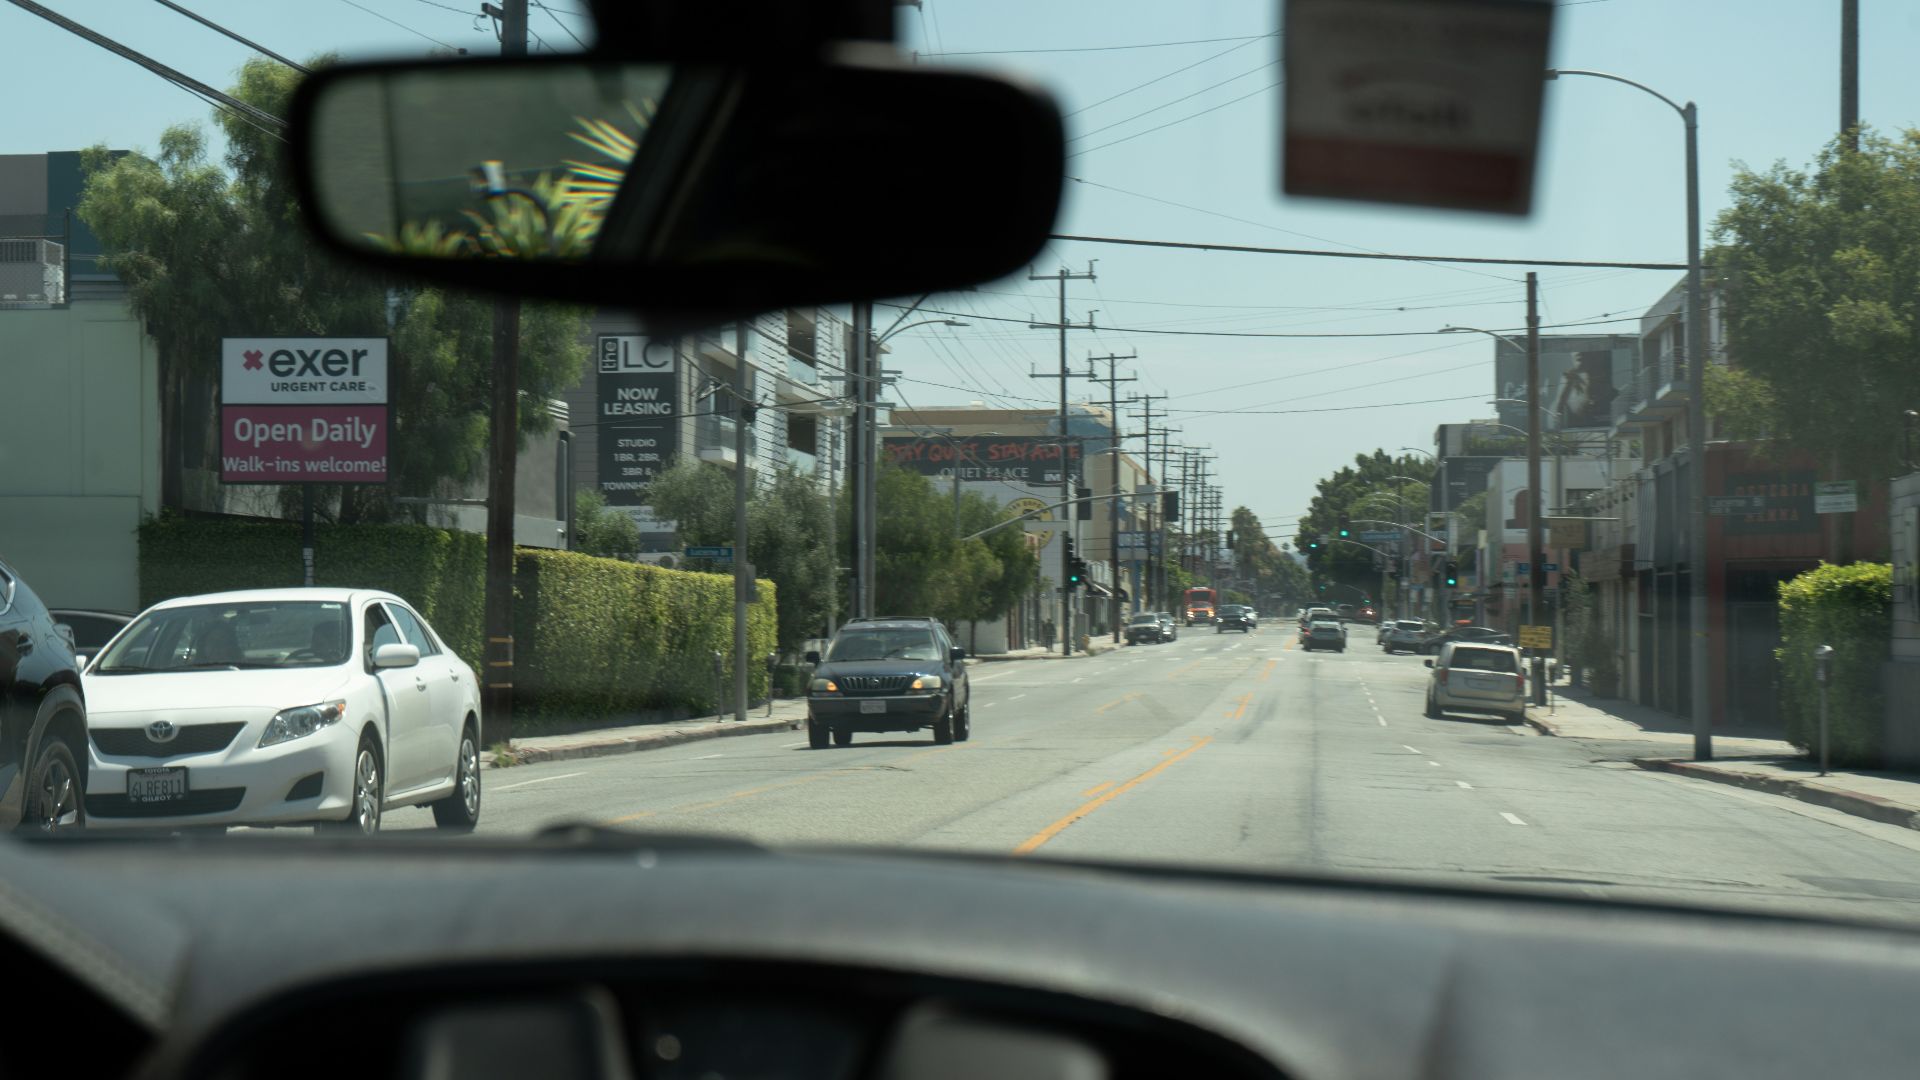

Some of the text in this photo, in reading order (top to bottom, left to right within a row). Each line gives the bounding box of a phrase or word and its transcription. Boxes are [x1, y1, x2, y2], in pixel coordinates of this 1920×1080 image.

[602, 341, 617, 369] the
[623, 341, 670, 368] LC
[268, 348, 368, 377] exer
[271, 381, 327, 392] URGENT
[329, 381, 366, 391] CARE
[617, 387, 659, 401] NOW
[604, 402, 671, 416] LEASING
[233, 416, 377, 448] Open Daily
[617, 438, 657, 447] STUDIO
[927, 443, 980, 463] QUET
[987, 442, 1030, 461] STAY
[222, 456, 387, 473] Walk-ins welcome!
[621, 467, 643, 476] 3BR
[986, 467, 1030, 478] PLACE
[1043, 473, 1080, 483] IMX
[132, 779, 182, 798] 6LRF811
